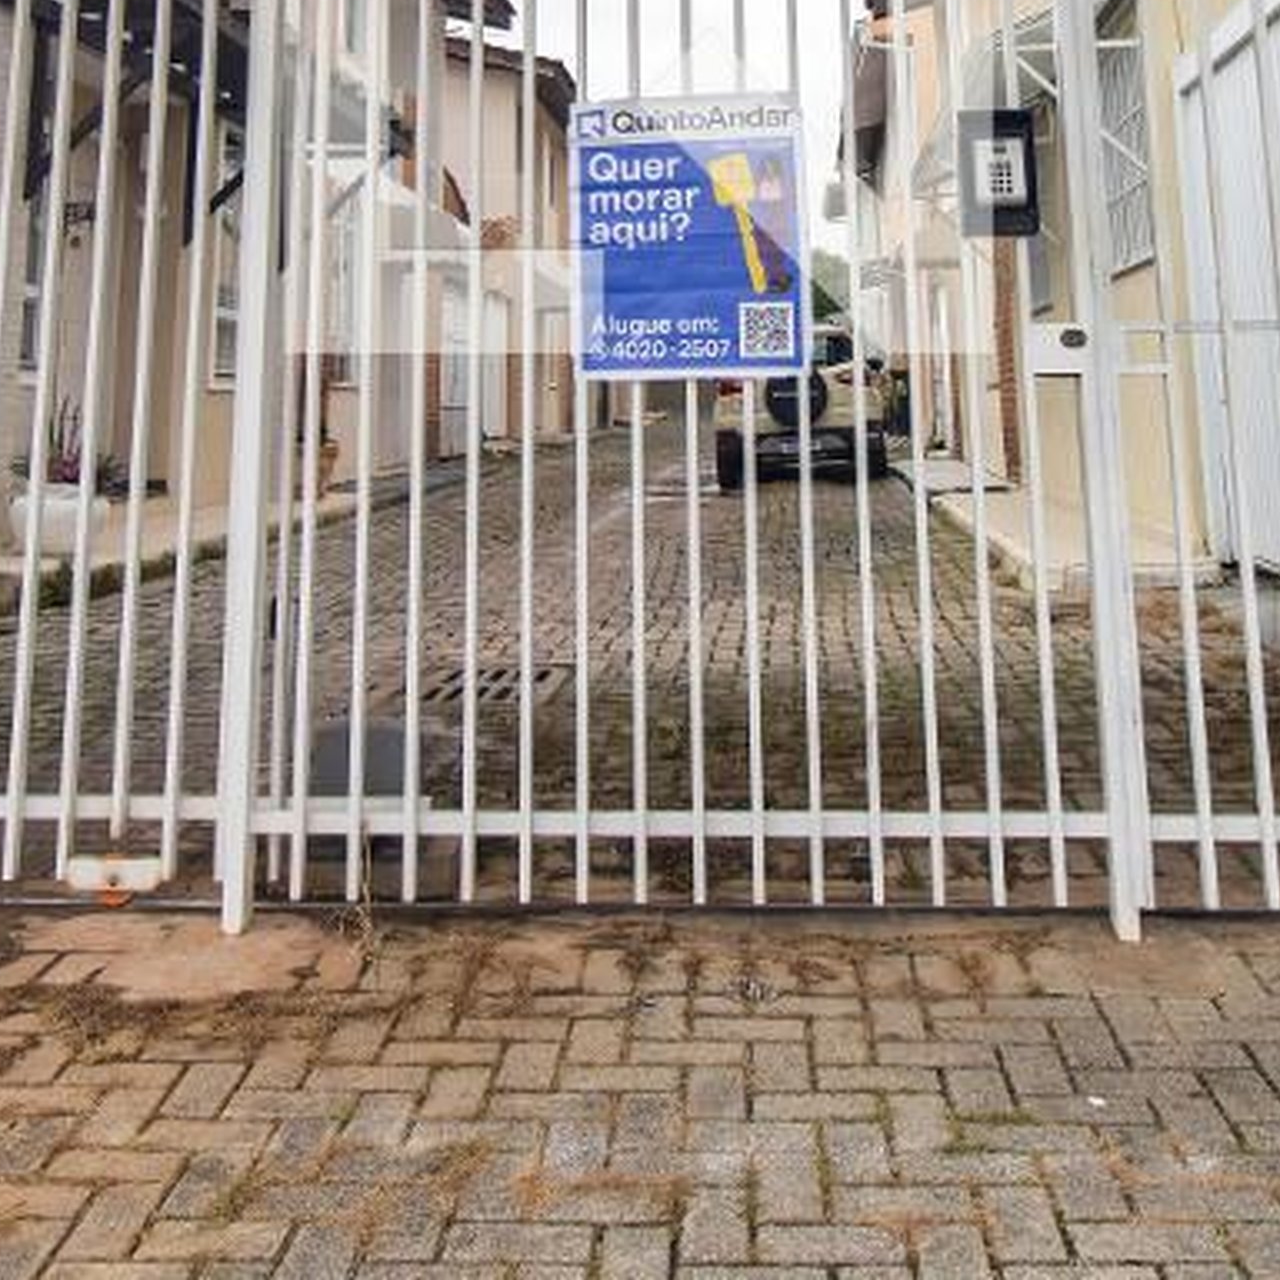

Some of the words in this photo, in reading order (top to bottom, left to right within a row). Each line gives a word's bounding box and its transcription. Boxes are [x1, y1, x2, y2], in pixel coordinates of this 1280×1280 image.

[612, 106, 793, 134] QuintoAndar
[588, 151, 681, 183] Quer
[588, 186, 701, 214] morar
[588, 213, 691, 250] aqui?
[591, 313, 671, 341] Alugue
[676, 317, 719, 335] em:
